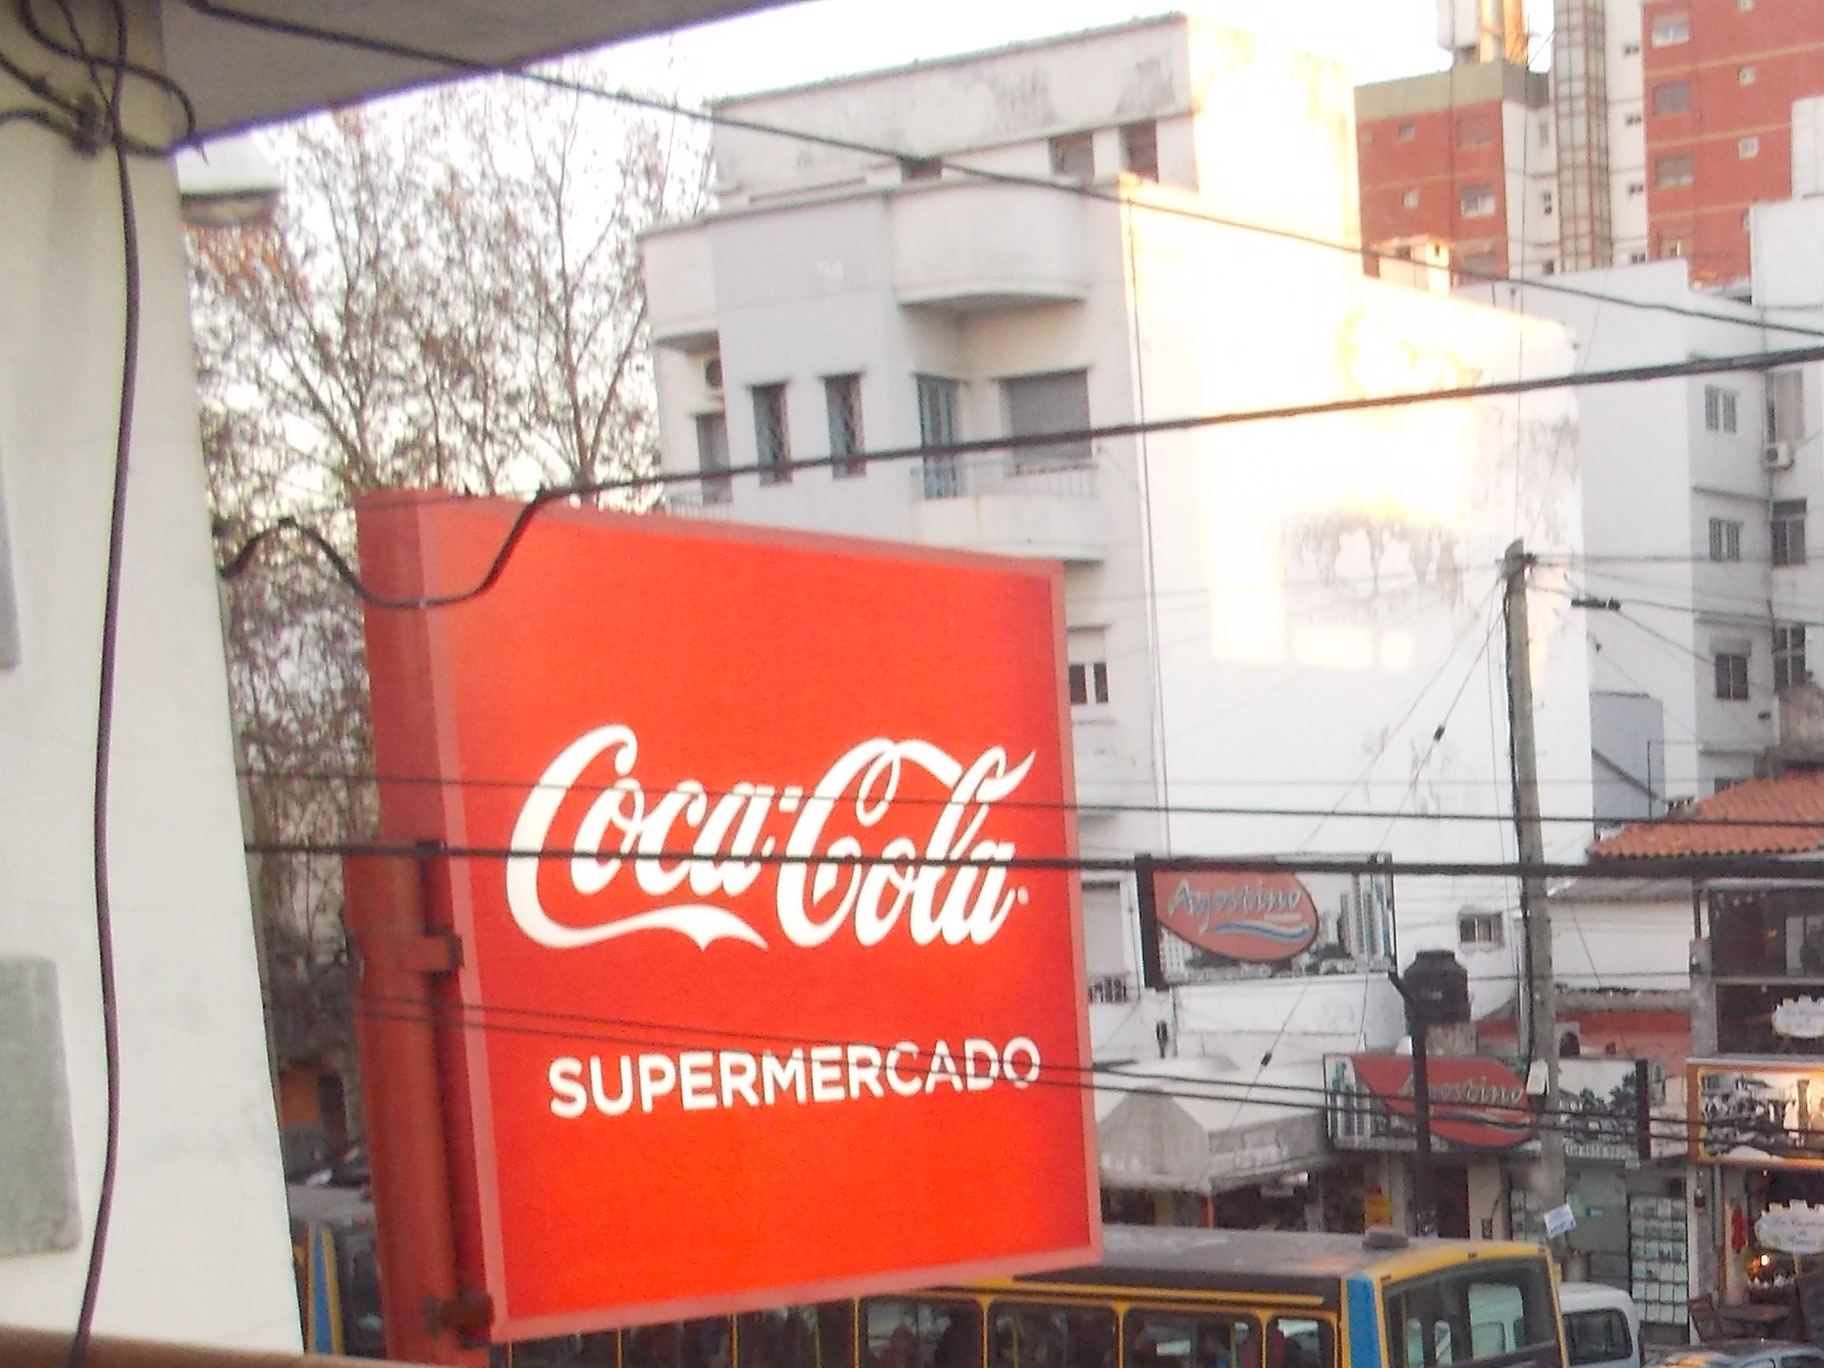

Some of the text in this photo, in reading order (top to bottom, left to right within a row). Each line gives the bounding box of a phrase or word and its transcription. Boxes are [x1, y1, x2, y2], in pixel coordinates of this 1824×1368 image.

[506, 723, 1037, 950] Coca-Cola
[1167, 878, 1302, 936] Agostino
[548, 1036, 1042, 1119] SUPERMERCADO
